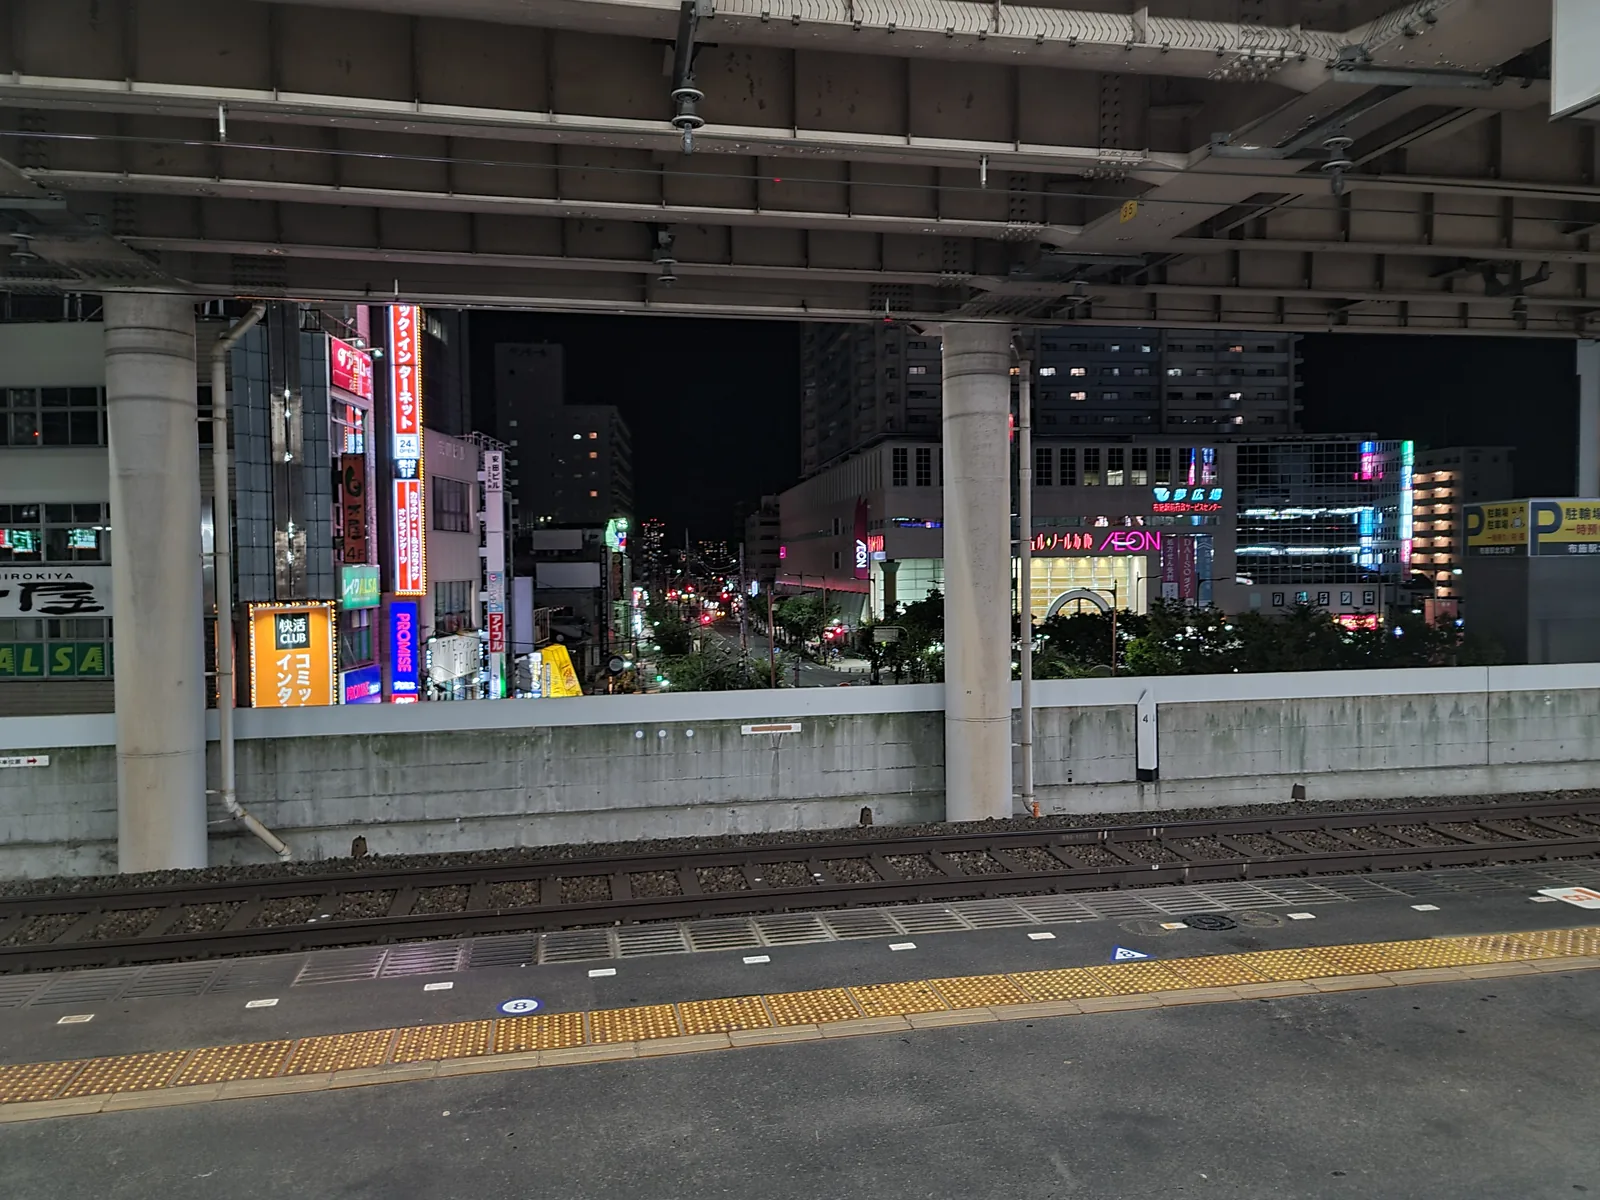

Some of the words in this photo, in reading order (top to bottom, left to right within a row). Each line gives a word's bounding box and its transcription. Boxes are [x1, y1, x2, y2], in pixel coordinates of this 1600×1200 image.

[1124, 203, 1133, 218] 35
[1099, 531, 1161, 551] AEON
[1531, 502, 1563, 556] P
[346, 546, 365, 560] 4F
[855, 539, 867, 569] AEON
[1183, 538, 1192, 576] DAISO
[0, 582, 105, 615] 屋
[279, 617, 306, 632] 快活
[280, 633, 307, 644] CLUB
[491, 614, 503, 652] アイフル
[396, 613, 412, 673] PROMISE
[276, 653, 292, 706] インタ
[296, 653, 312, 706] コミッ
[1142, 714, 1149, 723] 4
[513, 1001, 528, 1011] 8
